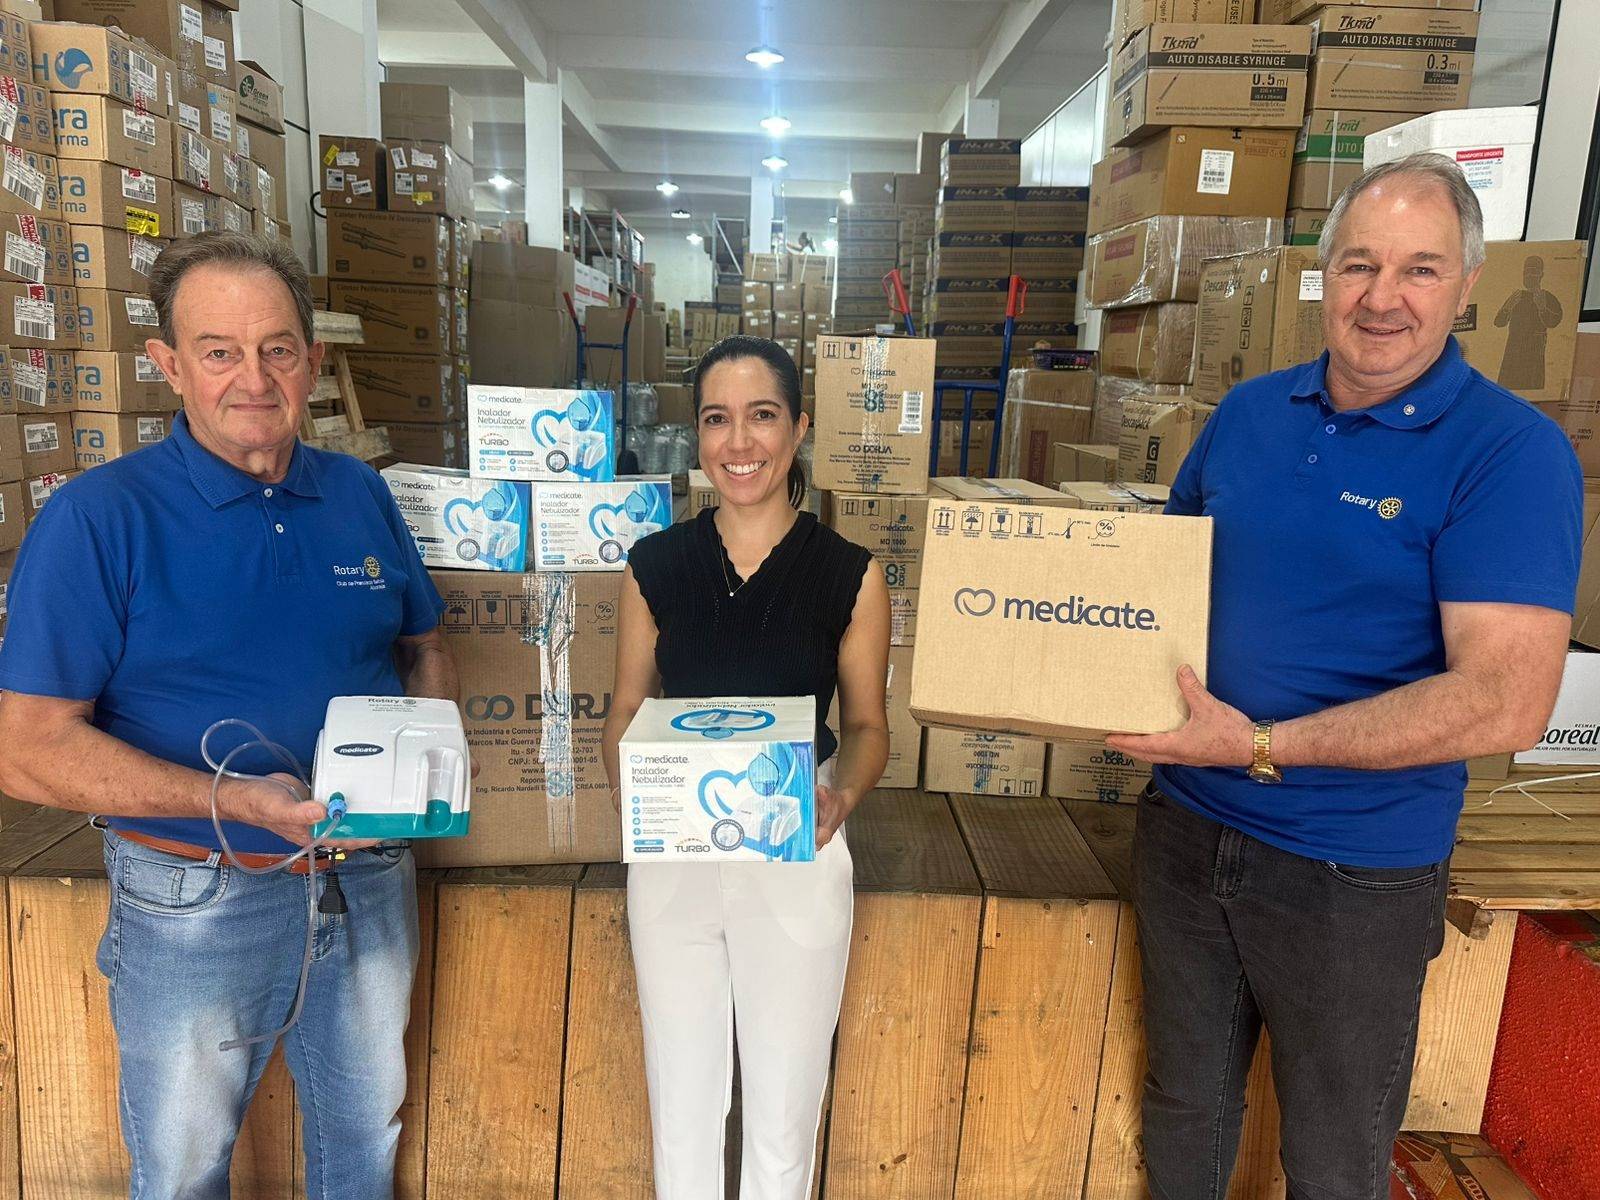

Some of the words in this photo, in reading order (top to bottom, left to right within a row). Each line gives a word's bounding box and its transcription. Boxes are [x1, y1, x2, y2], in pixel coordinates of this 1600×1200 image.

[1342, 34, 1369, 44] AUTO
[1372, 35, 1413, 46] DISABLE
[1416, 37, 1457, 48] SYRINGE
[1167, 55, 1195, 64] AUTO
[1197, 55, 1241, 65] DISABLE
[1243, 56, 1286, 66] SYRINGE
[477, 408, 511, 417] Inalador
[477, 416, 526, 425] Nebulizador
[478, 438, 510, 447] TURBO
[1340, 491, 1378, 510] Rotary
[333, 565, 365, 577] Rotary
[495, 738, 509, 746] Max
[510, 737, 536, 746] Guerra
[340, 746, 378, 754] medicate
[644, 755, 689, 764] medicate
[631, 767, 670, 775] Inalador
[631, 775, 686, 784] Nebulizador
[475, 785, 488, 794] Eng.
[491, 785, 516, 793] Ricardo
[674, 844, 711, 853] TURBO
